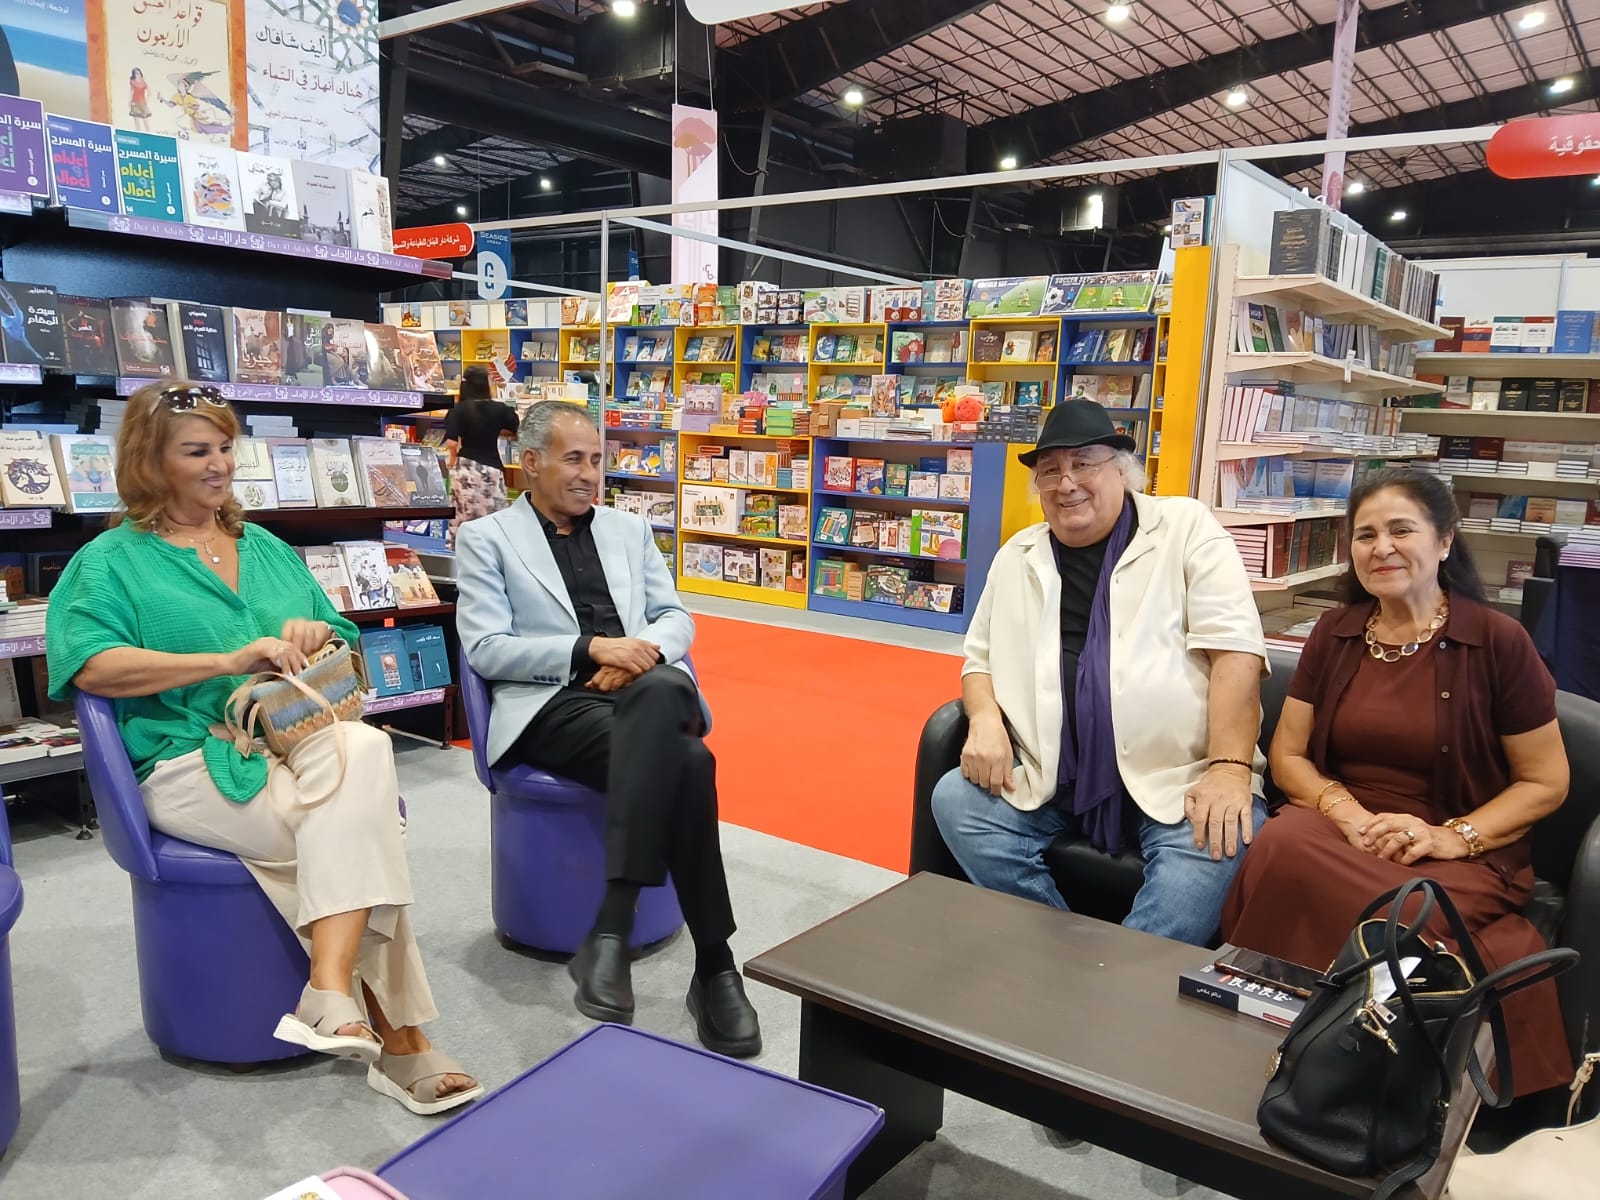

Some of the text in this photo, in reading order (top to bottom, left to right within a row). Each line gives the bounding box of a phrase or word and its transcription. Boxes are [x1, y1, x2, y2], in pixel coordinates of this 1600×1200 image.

[137, 23, 190, 48] الأربعون
[296, 70, 308, 90] في
[0, 114, 41, 130] سيرة الم
[51, 135, 112, 152] سيرة المسرح
[118, 148, 177, 164] سيرة المسرح
[235, 236, 247, 245] دار
[480, 231, 509, 241] SEASIDE
[354, 252, 365, 262] دار
[28, 305, 55, 316] سيدة
[28, 315, 59, 326] المقام
[0, 515, 17, 525] الآدا
